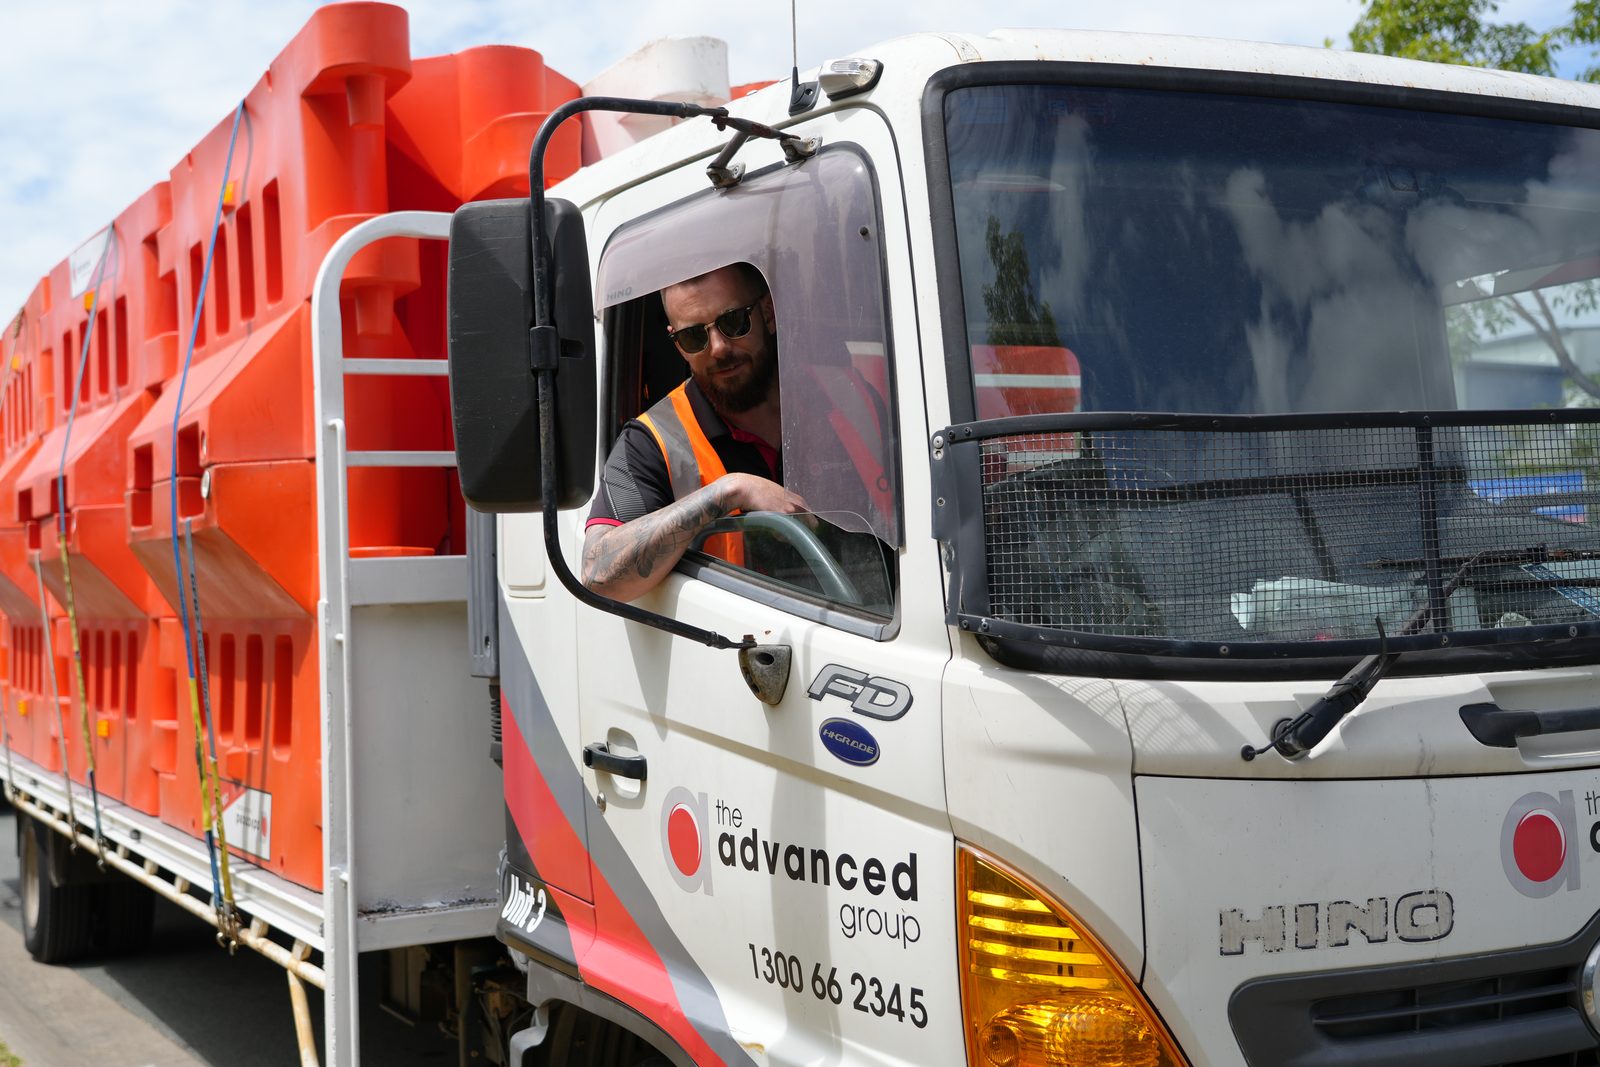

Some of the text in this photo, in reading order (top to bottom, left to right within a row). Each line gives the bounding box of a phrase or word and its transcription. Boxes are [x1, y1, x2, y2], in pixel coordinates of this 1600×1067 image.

[607, 286, 632, 301] HINO
[807, 663, 914, 721] FD
[716, 799, 743, 828] the
[718, 828, 919, 901] advanced
[502, 873, 547, 933] Unit 3
[839, 903, 921, 949] group
[1220, 890, 1454, 956] HINO
[749, 943, 928, 1029] 1300 66 2345
